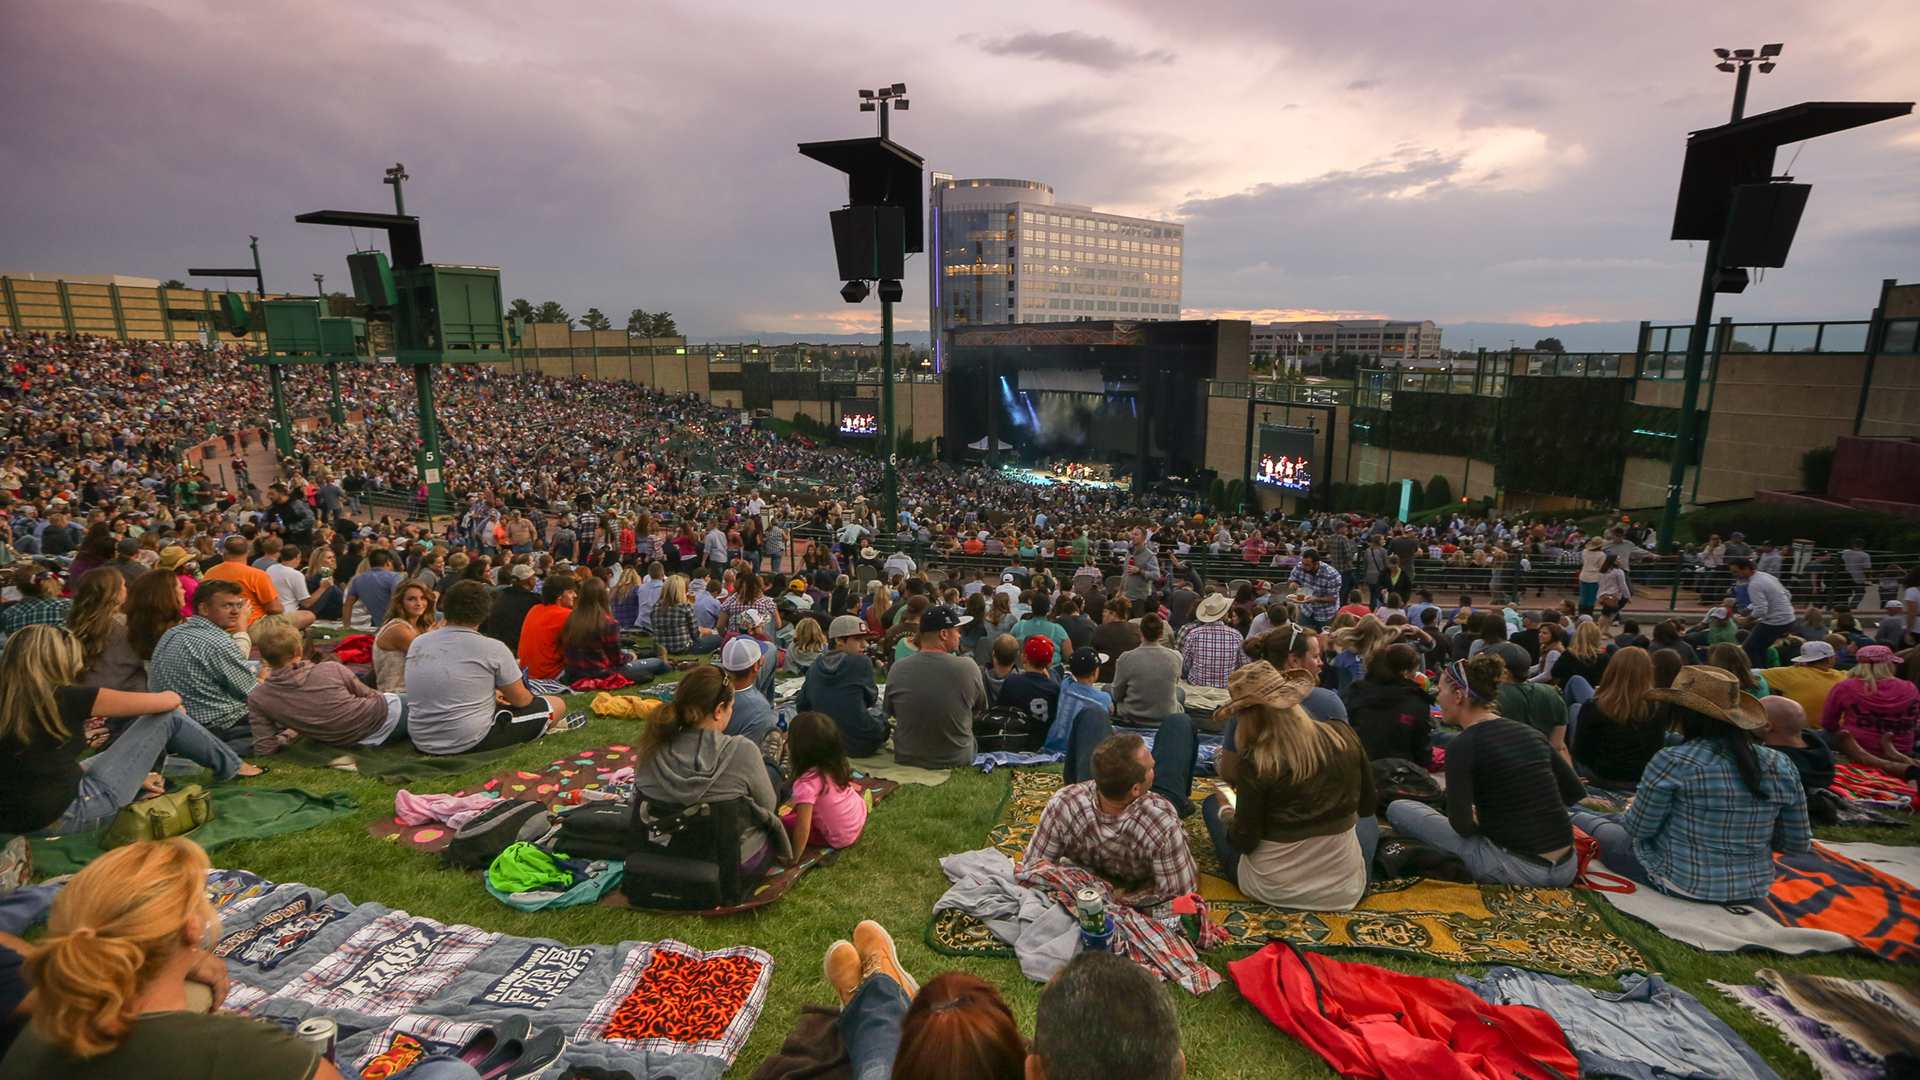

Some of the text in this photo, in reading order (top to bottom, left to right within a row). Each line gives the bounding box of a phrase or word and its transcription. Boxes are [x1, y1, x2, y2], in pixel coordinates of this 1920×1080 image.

[426, 451, 434, 462] 5
[889, 453, 897, 465] 6
[1030, 698, 1049, 722] 9
[497, 946, 582, 1004] FIRE
